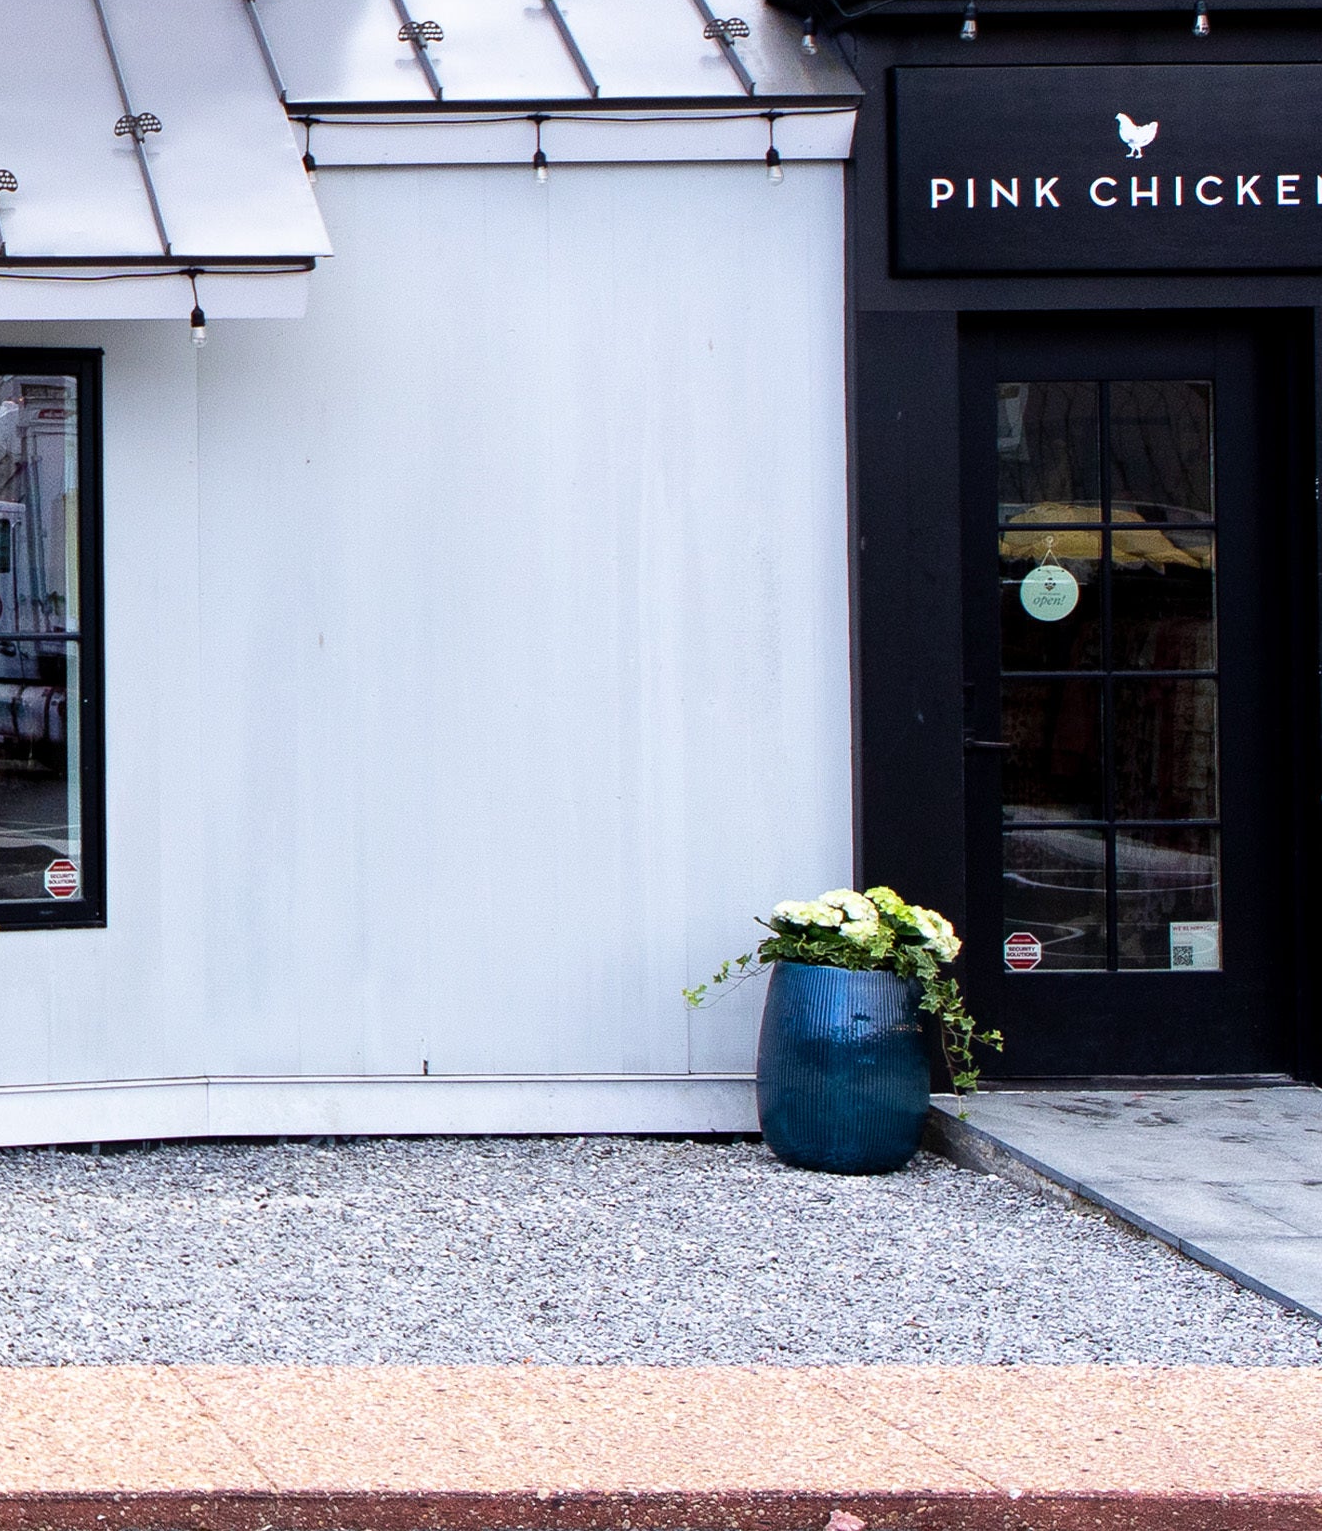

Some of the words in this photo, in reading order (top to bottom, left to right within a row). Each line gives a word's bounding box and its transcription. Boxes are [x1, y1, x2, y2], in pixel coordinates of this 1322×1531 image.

[930, 176, 1060, 209] PINK
[1089, 174, 1322, 207] CHICKE
[1033, 595, 1066, 608] open!
